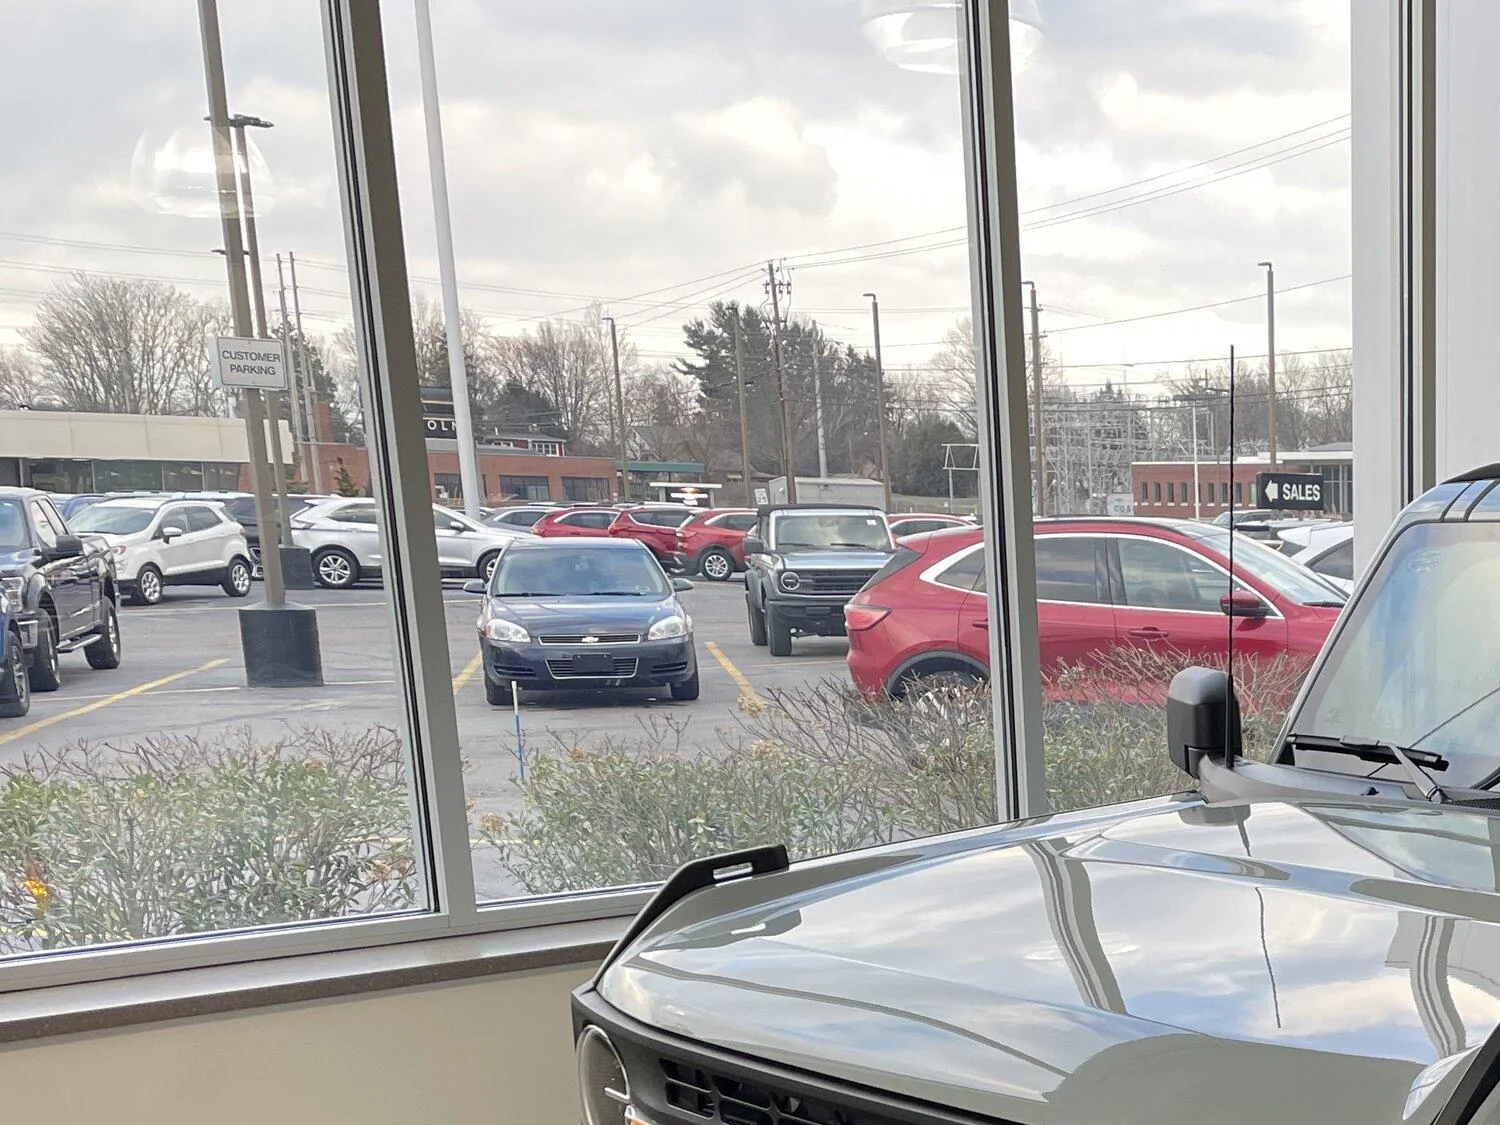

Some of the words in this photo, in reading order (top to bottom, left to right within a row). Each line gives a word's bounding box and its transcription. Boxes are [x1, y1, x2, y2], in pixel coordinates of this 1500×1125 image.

[222, 350, 281, 362] CUSTOMER
[230, 364, 276, 375] PARKING
[1282, 483, 1321, 501] SALES
